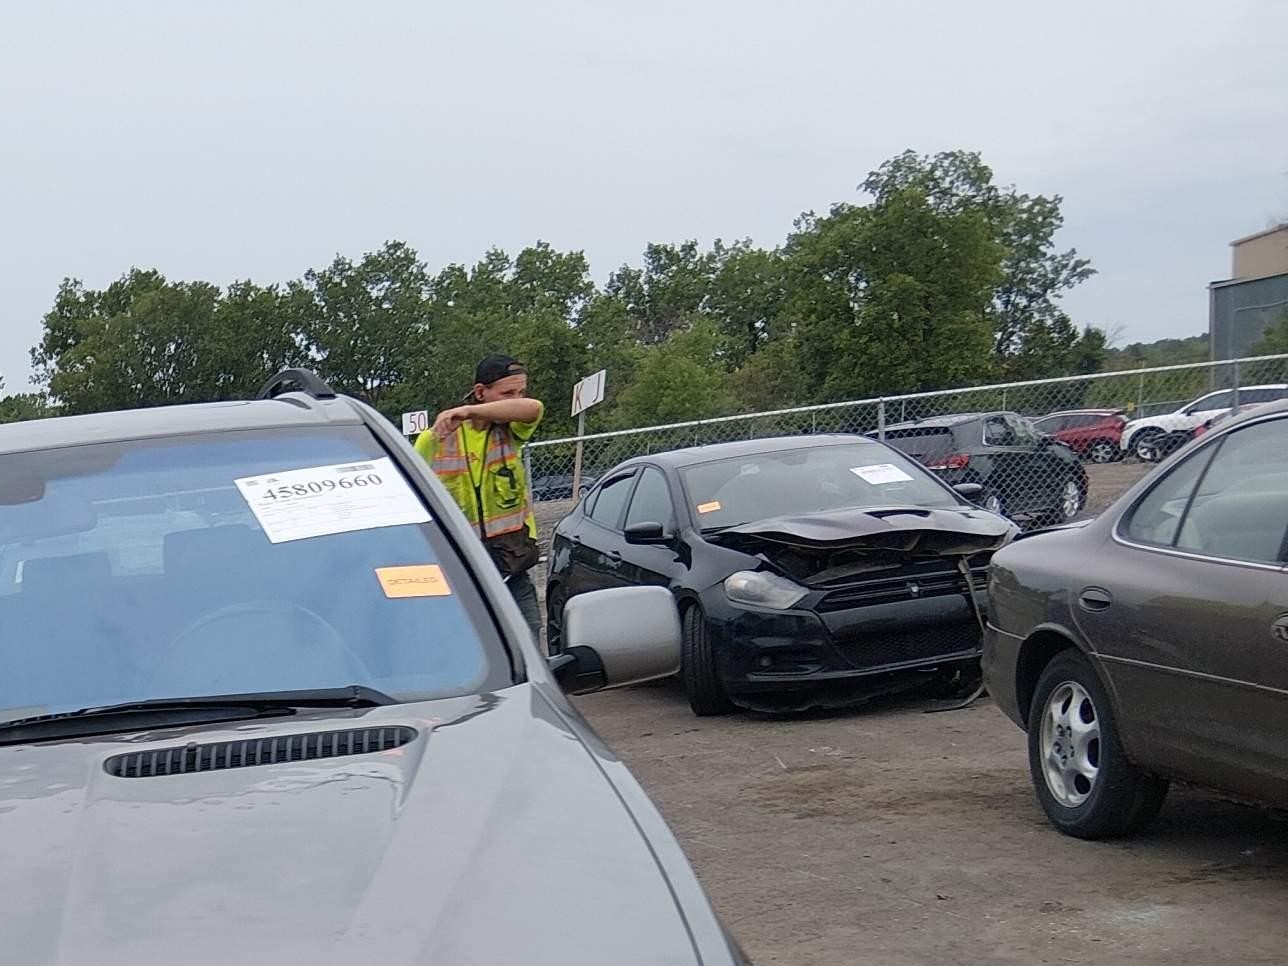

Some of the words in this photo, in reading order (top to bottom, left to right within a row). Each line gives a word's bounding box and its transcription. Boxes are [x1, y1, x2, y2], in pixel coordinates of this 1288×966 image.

[574, 382, 585, 413] K
[592, 373, 601, 403] J
[409, 412, 427, 433] 50
[263, 473, 383, 500] 45809660
